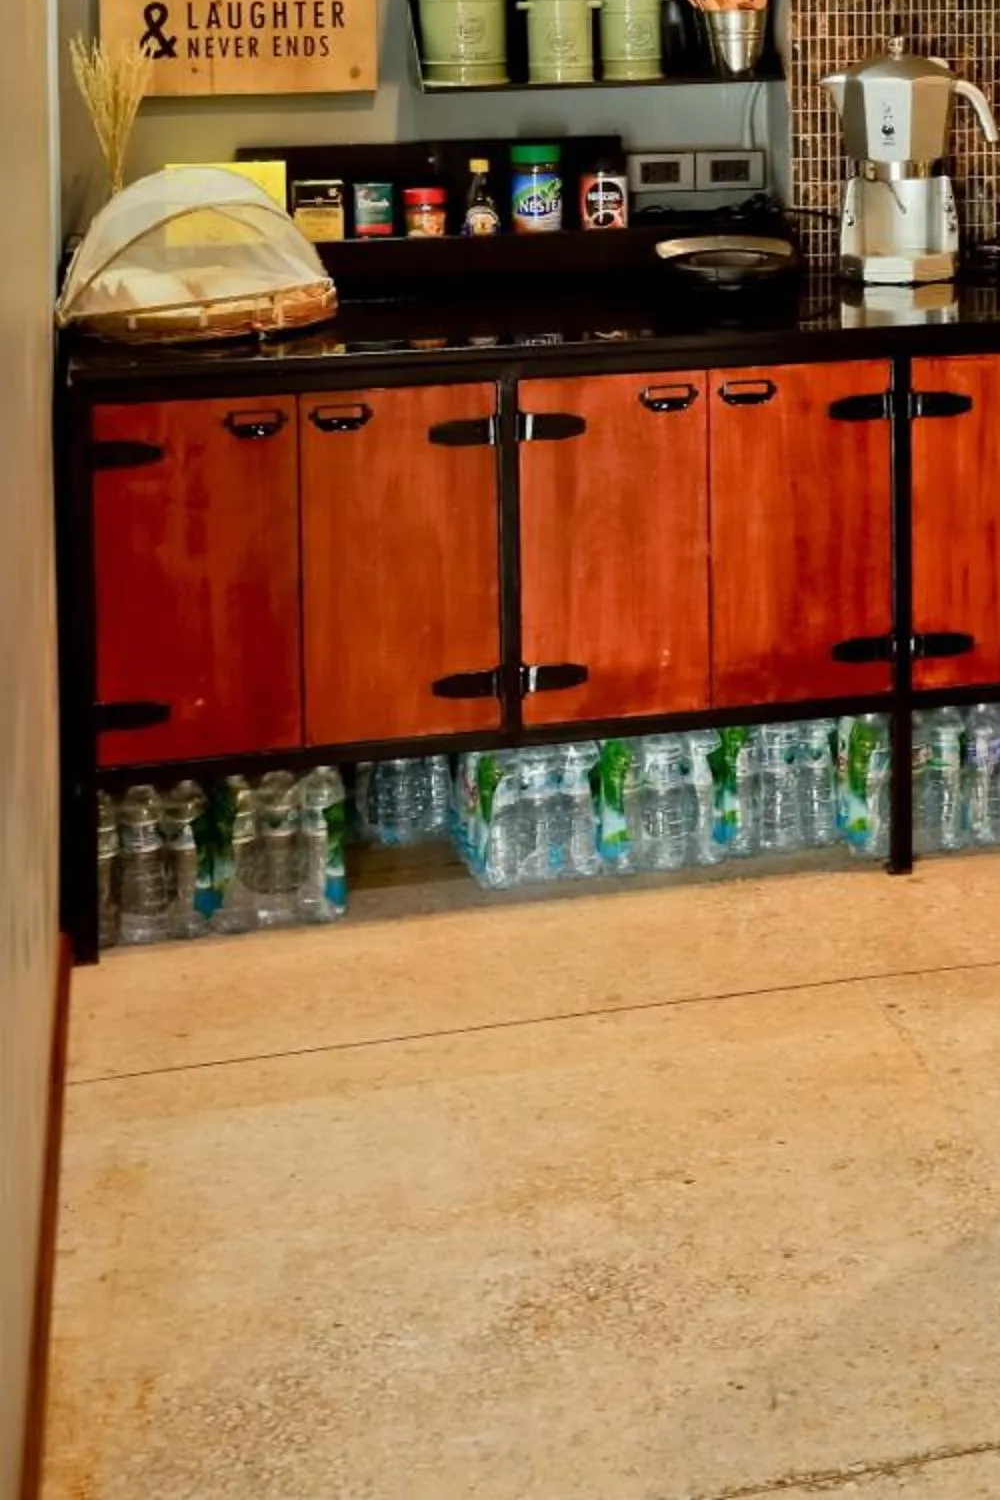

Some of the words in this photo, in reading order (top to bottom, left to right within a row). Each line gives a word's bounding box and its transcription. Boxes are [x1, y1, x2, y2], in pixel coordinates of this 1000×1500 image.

[139, 2, 177, 59] &
[187, 1, 345, 30] LAUGHTER
[187, 35, 259, 59] NEVER
[273, 35, 329, 57] ENDS
